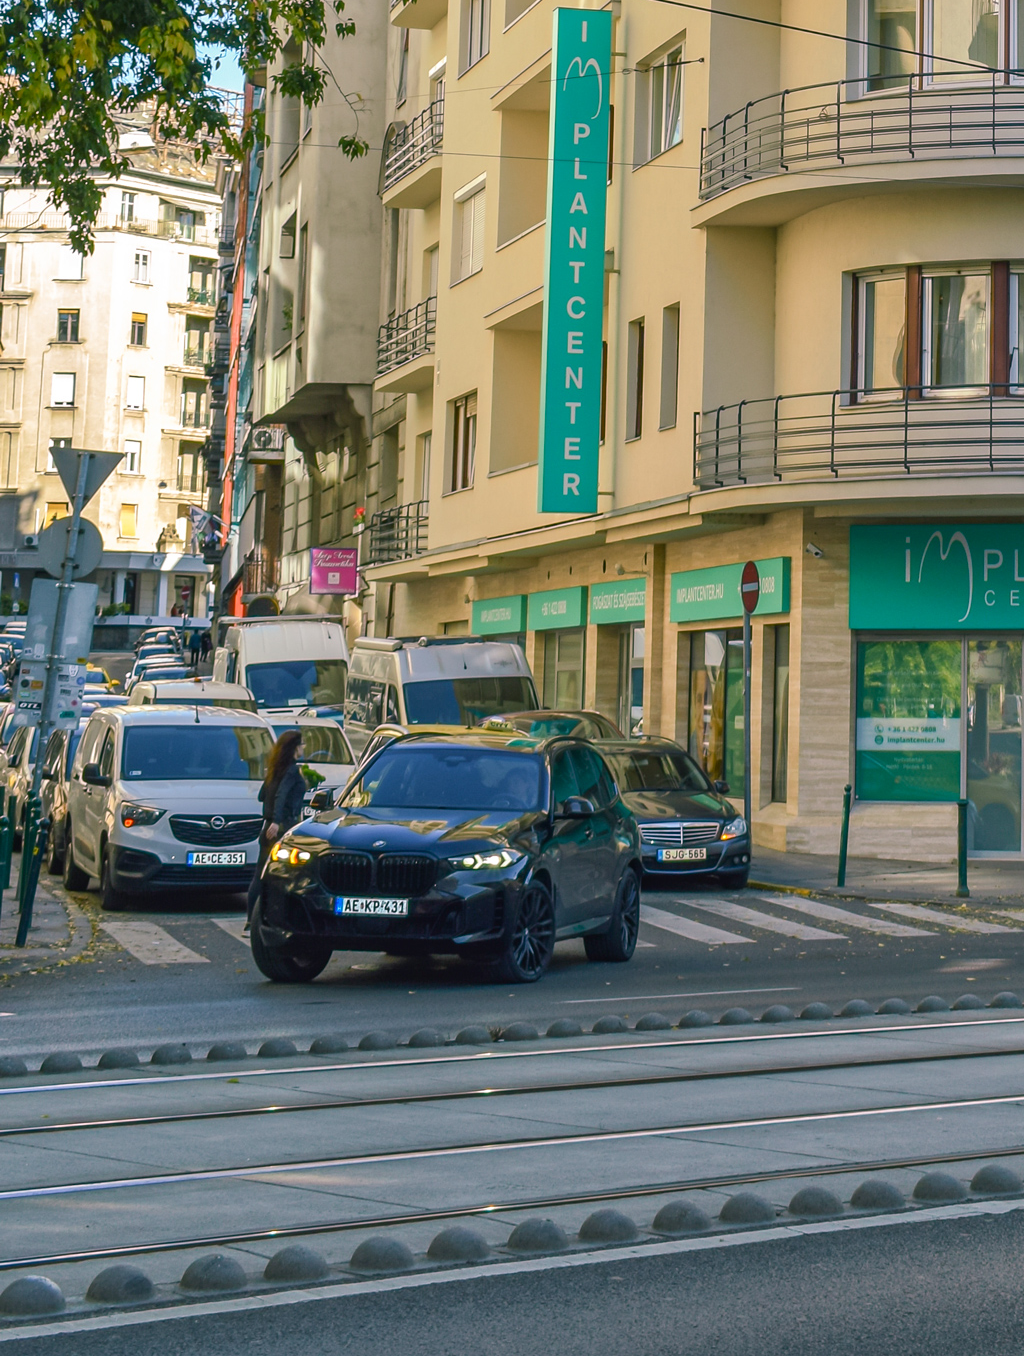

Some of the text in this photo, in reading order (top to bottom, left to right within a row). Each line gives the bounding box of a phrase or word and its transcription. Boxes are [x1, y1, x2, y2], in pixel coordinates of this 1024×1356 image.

[593, 591, 613, 610] FOGÁSZAT
[613, 590, 619, 608] ÉS
[677, 584, 724, 603] IMPLANTCENTER.HU
[887, 737, 945, 745] implantcenter.hu
